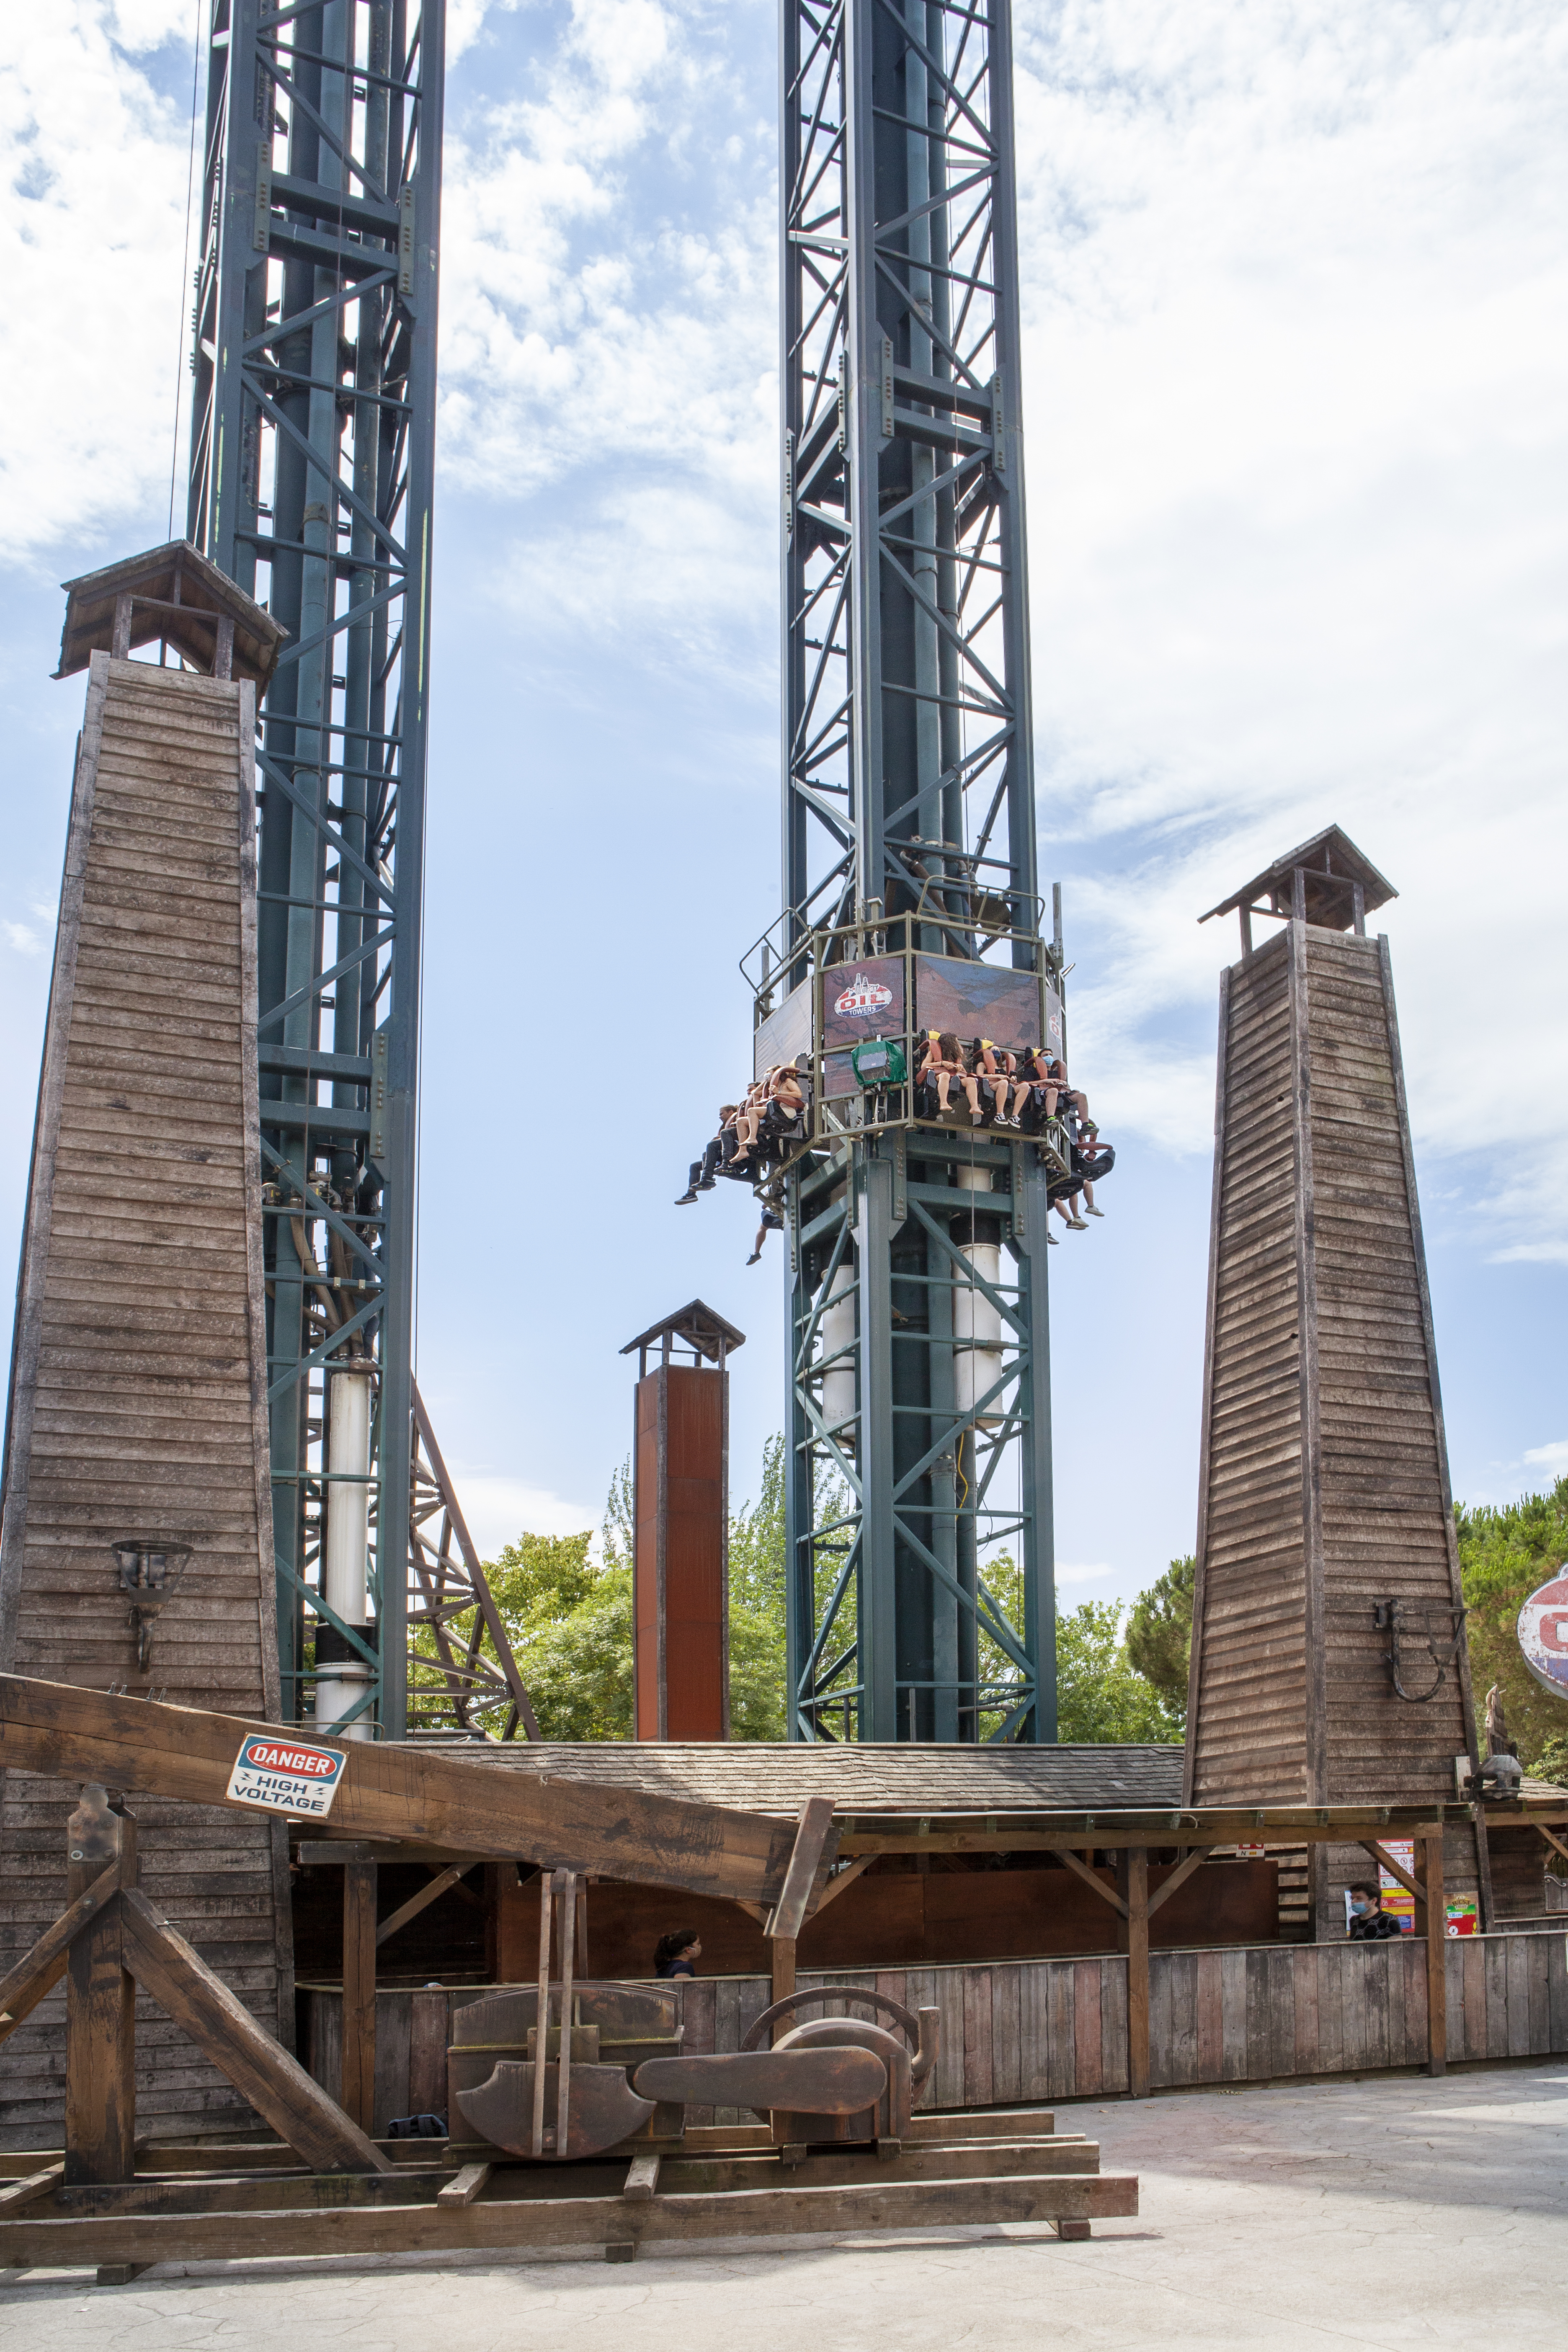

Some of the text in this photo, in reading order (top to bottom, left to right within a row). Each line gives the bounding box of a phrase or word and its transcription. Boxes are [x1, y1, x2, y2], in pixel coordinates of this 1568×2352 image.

[840, 994, 885, 1010] OIL
[849, 1006, 876, 1015] TOWERS
[253, 1746, 330, 1774] DANGER
[256, 1776, 308, 1794] HIGH
[234, 1785, 325, 1811] VOLTAGE
